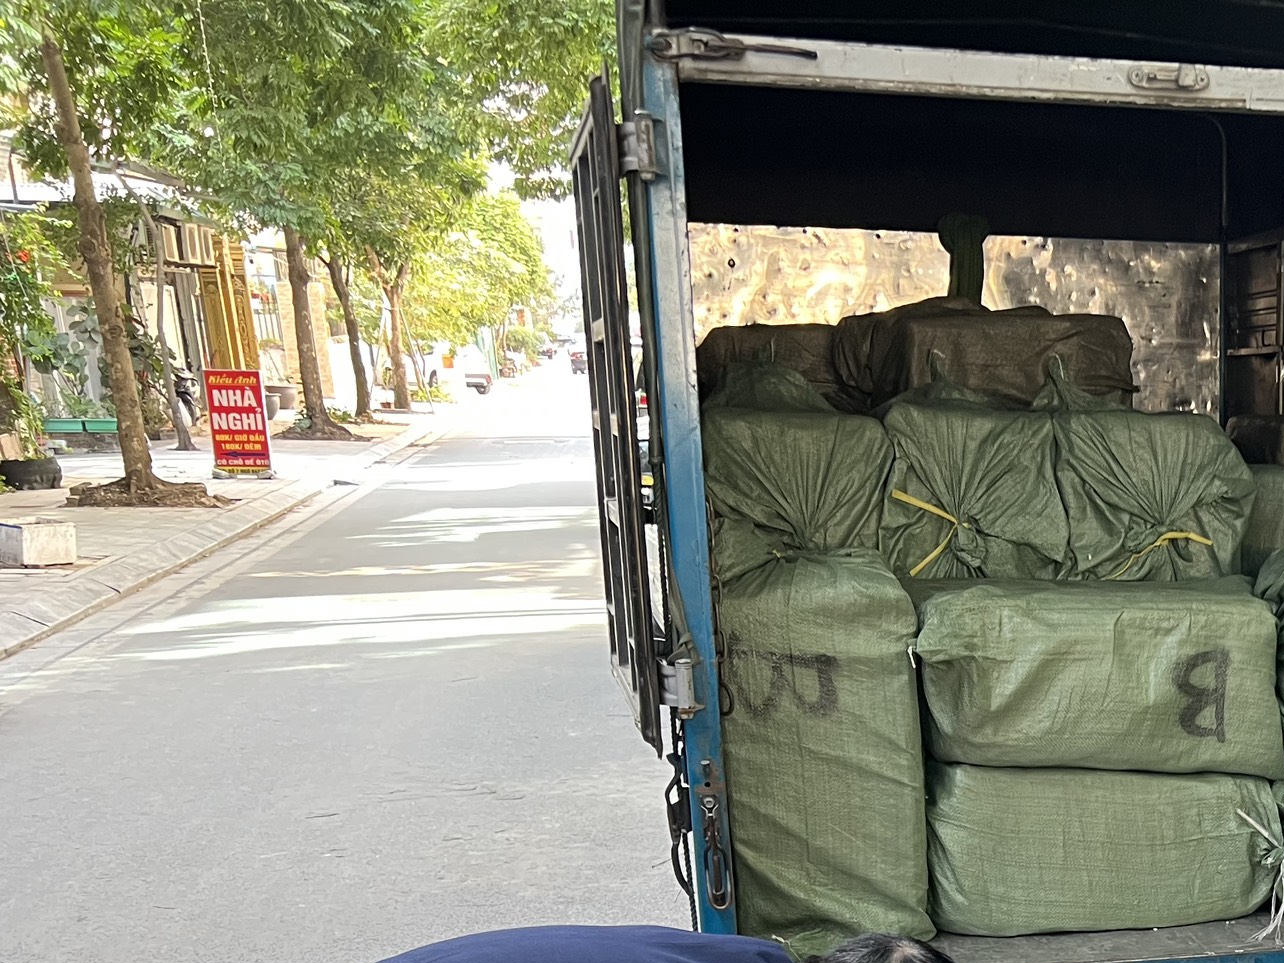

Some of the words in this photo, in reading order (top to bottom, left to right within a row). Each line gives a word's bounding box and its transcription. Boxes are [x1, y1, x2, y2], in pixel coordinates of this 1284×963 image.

[234, 375, 257, 384] Anh
[211, 386, 258, 407] NHÀ
[211, 407, 264, 430] NGHỈ
[1171, 647, 1231, 743] B
